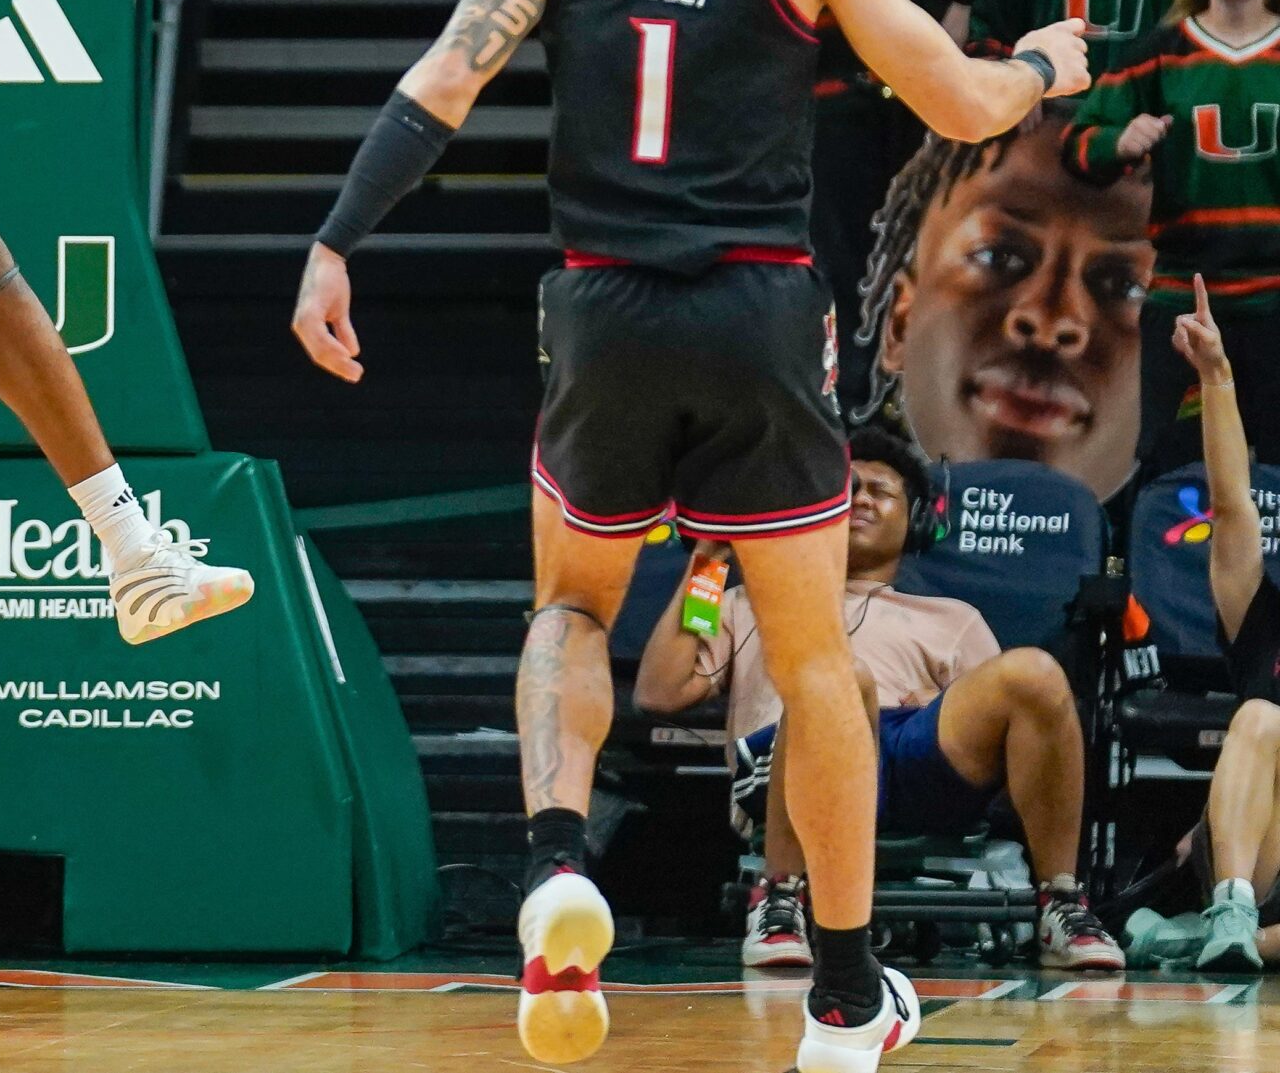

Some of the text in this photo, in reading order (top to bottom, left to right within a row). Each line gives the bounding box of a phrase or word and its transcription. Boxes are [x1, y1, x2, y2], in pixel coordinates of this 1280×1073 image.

[629, 16, 677, 164] 1
[1192, 102, 1280, 161] U
[962, 486, 1014, 514] City
[961, 509, 1070, 534] National
[959, 530, 1025, 556] Bank
[39, 598, 115, 620] HEALTH
[18, 708, 194, 728] CADILLAC
